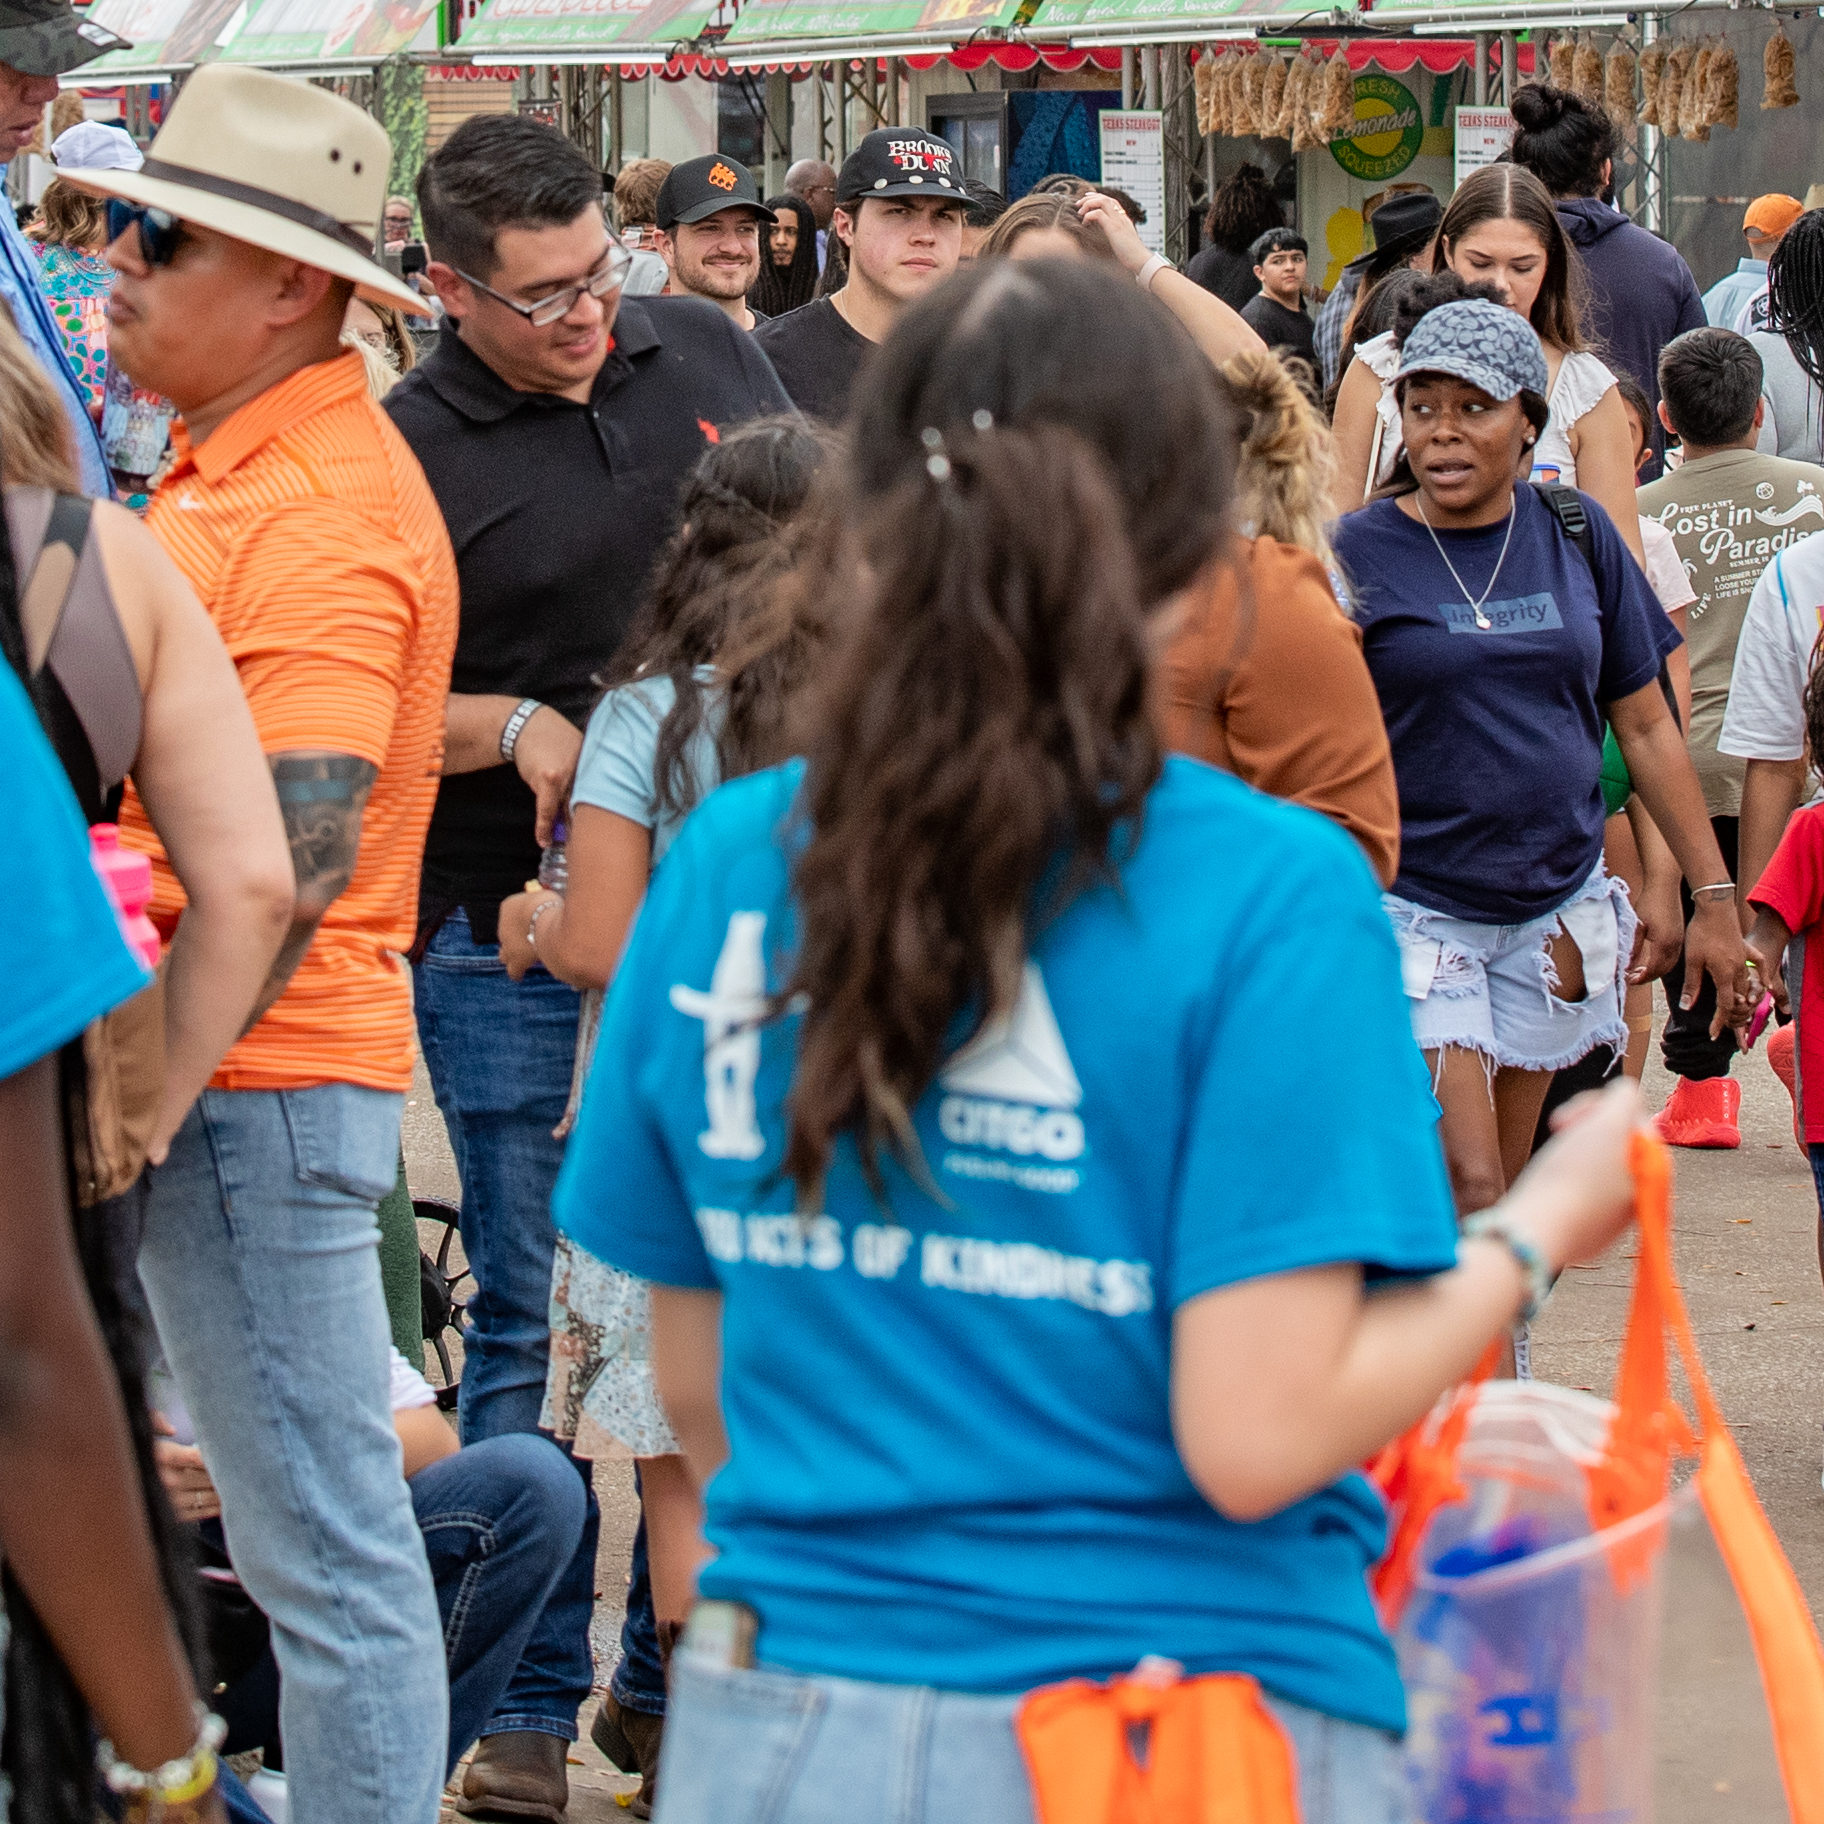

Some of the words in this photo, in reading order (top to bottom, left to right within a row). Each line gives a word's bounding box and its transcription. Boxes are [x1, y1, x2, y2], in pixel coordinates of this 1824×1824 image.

[1332, 106, 1417, 141] Lemonade
[1459, 114, 1482, 127] TEXAS
[887, 140, 952, 162] BROOKS
[901, 154, 951, 176] DUNN
[1648, 502, 1720, 538] Lost
[1728, 505, 1752, 527] in
[1714, 581, 1739, 591] LOOSE
[1715, 590, 1732, 599] LIFE
[1689, 592, 1712, 620] LIFE
[939, 1095, 1085, 1161] CITGO
[922, 1231, 1154, 1318] KINDNESS
